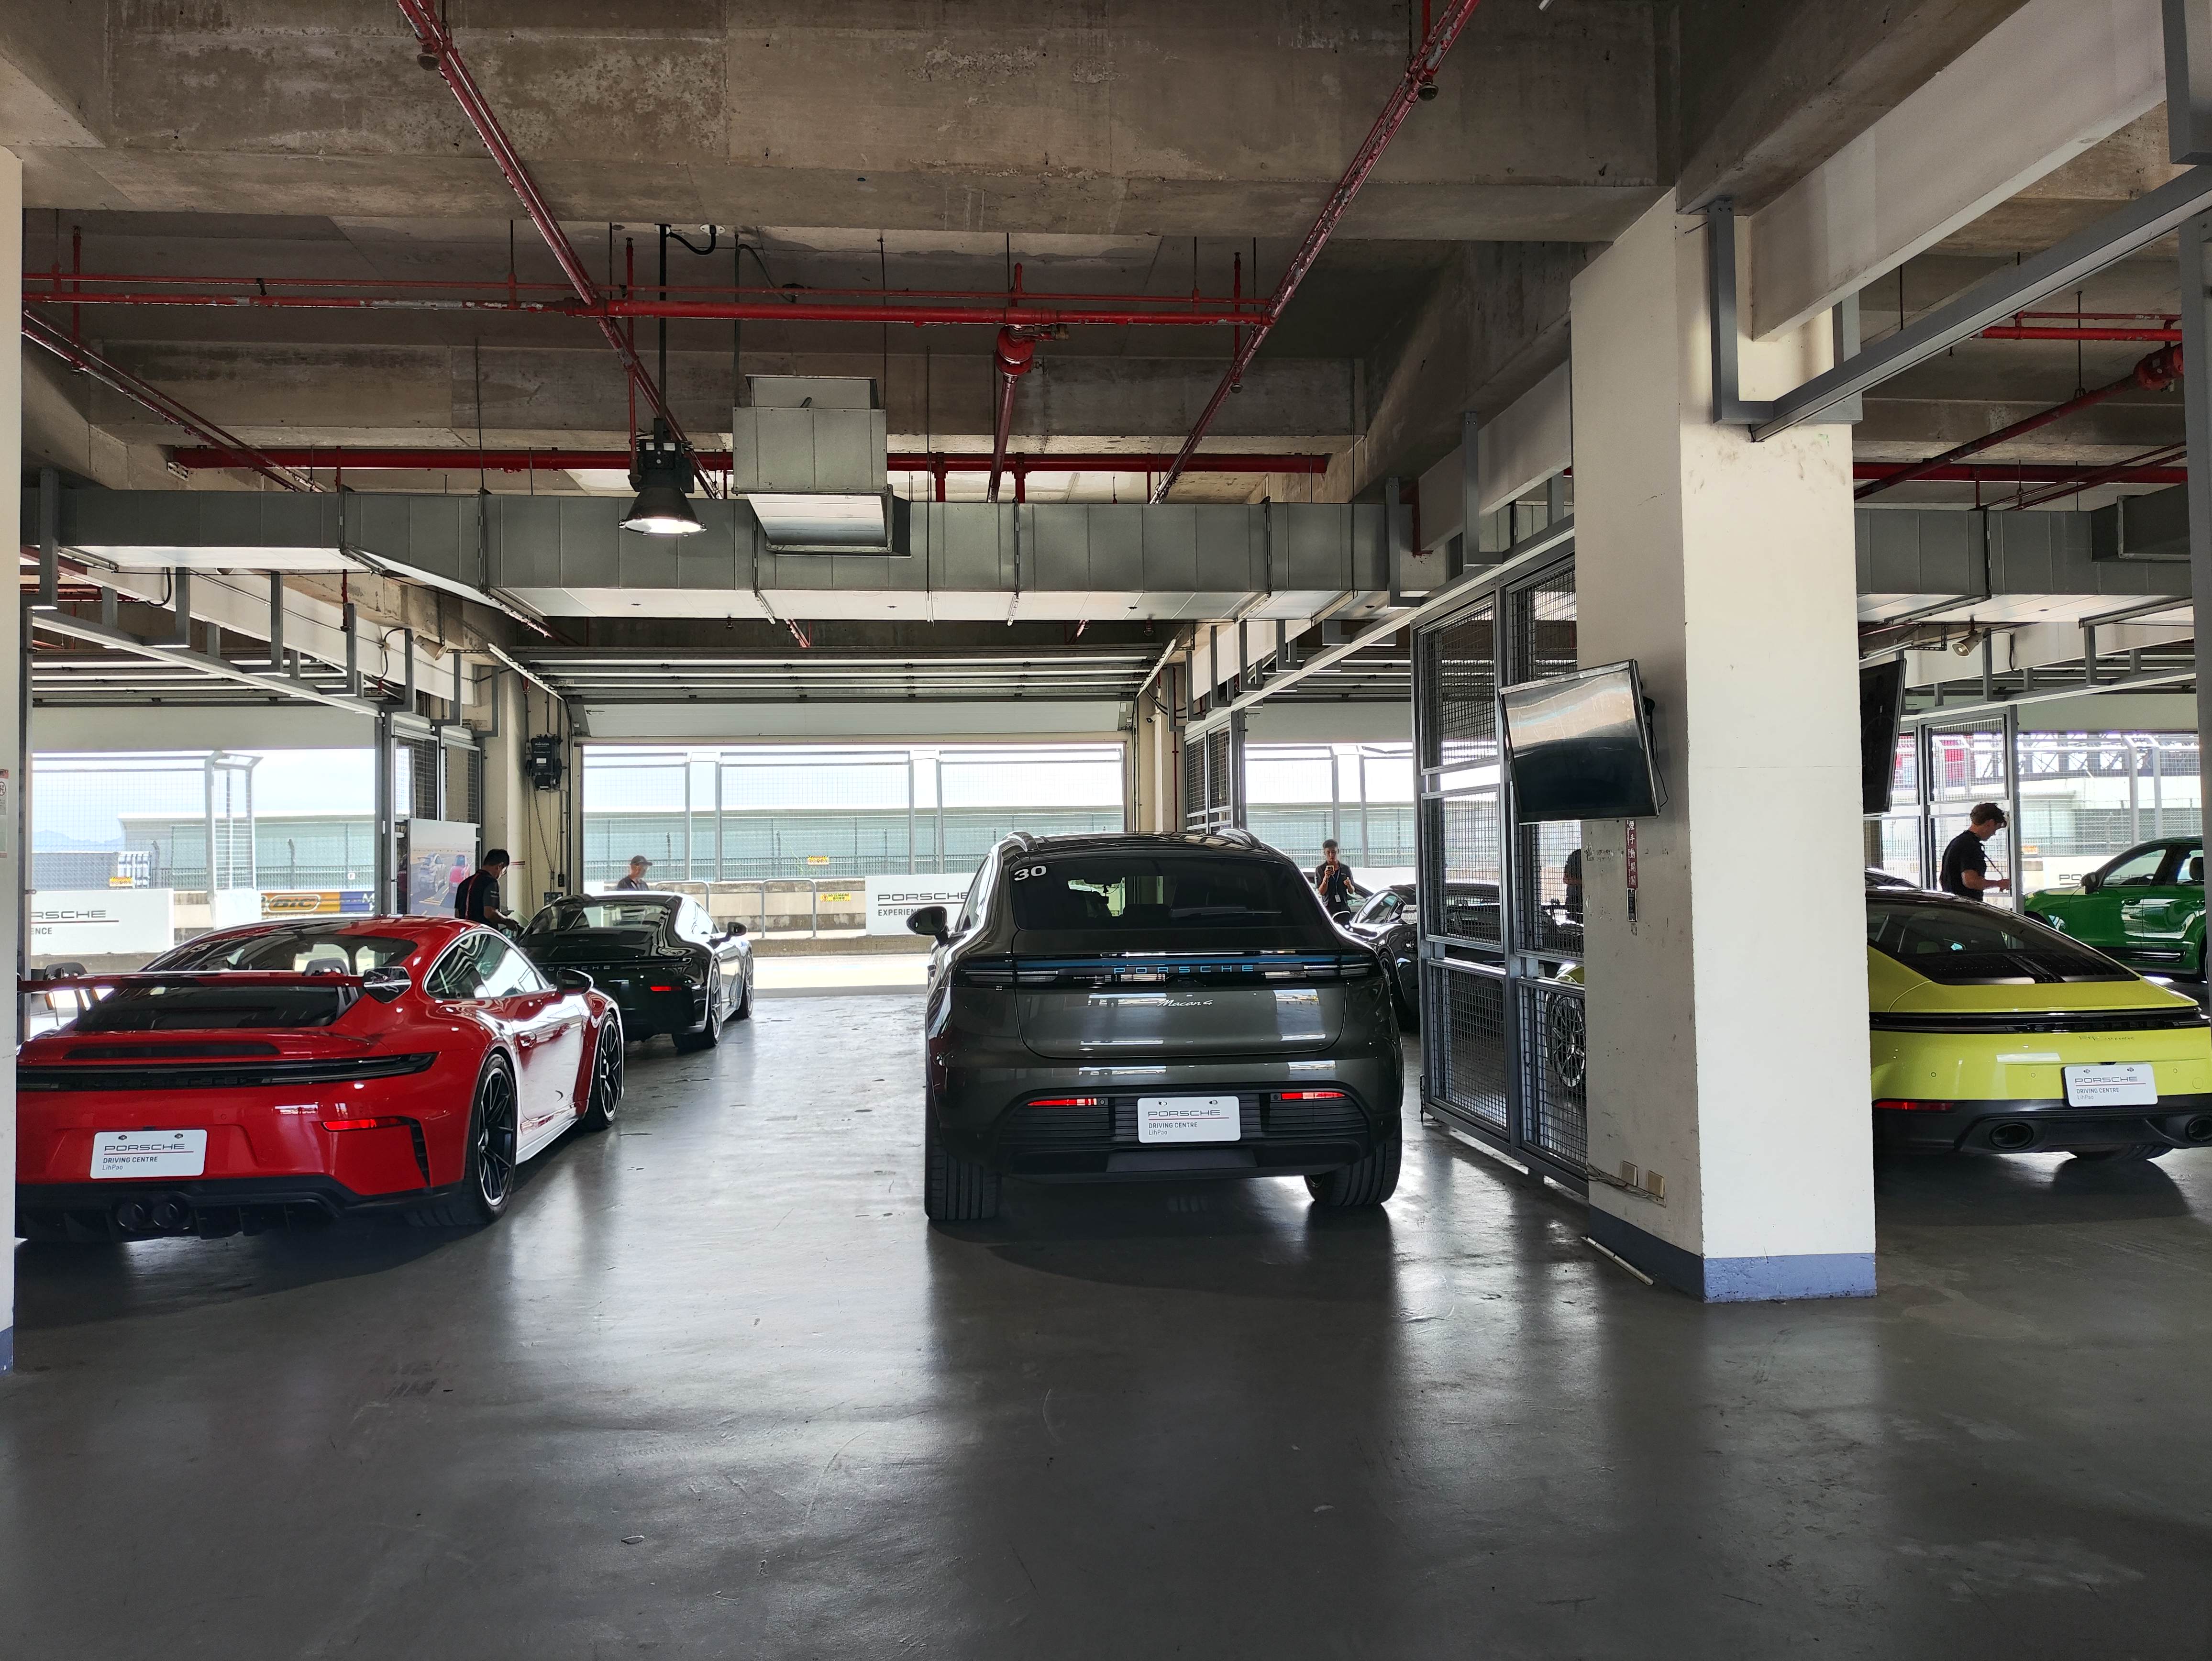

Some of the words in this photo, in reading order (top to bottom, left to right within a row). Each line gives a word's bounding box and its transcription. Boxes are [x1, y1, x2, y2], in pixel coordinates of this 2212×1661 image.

[1014, 865, 1047, 881] 30
[878, 892, 968, 902] PORSCHE
[1114, 965, 1254, 974] PORSCHE
